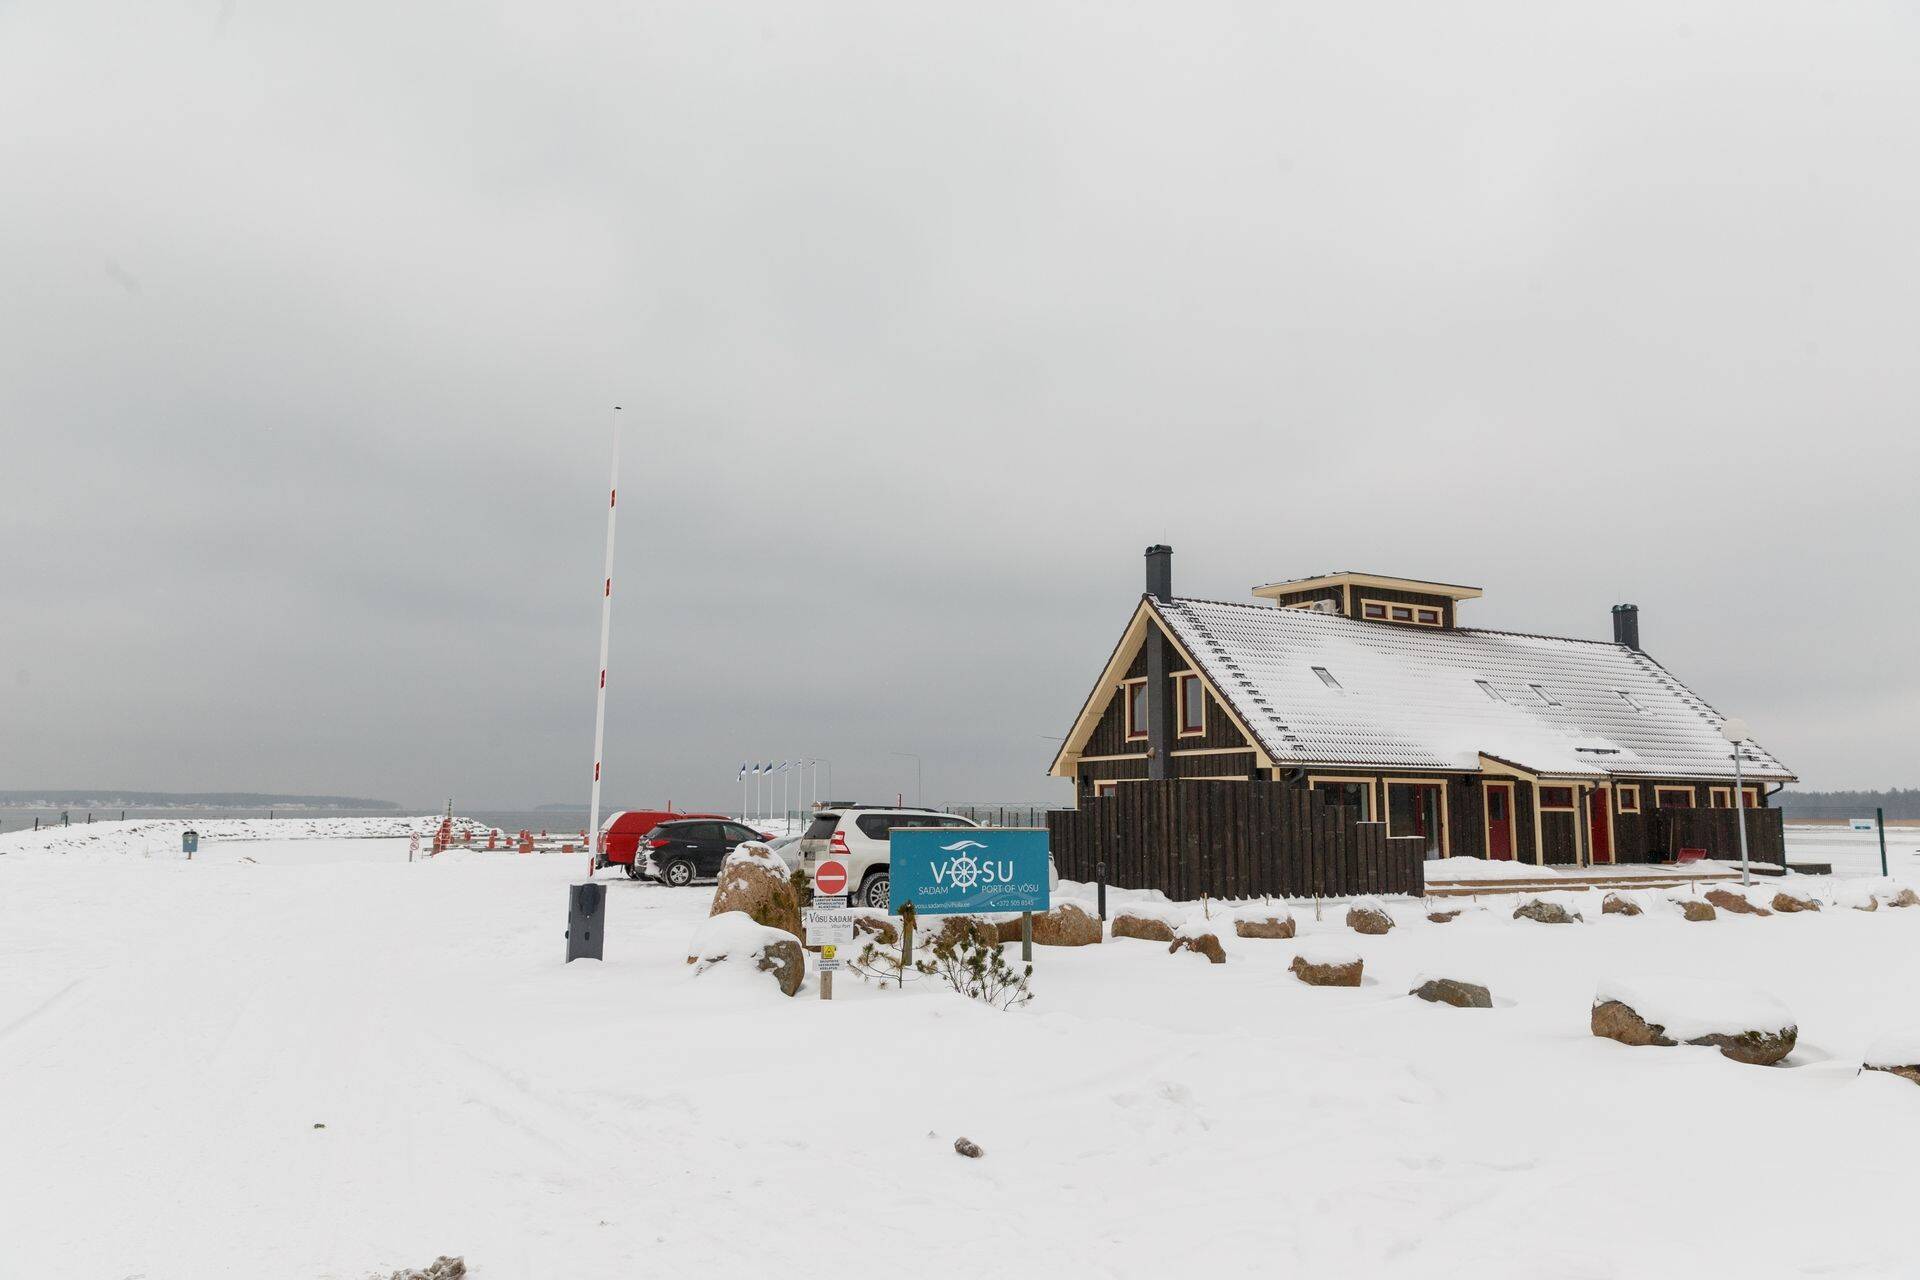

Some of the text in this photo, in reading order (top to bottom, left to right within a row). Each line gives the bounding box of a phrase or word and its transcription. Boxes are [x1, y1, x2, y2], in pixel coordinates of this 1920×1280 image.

[918, 886, 949, 895] SADAM
[981, 884, 1003, 894] PORT
[1004, 884, 1016, 893] OF
